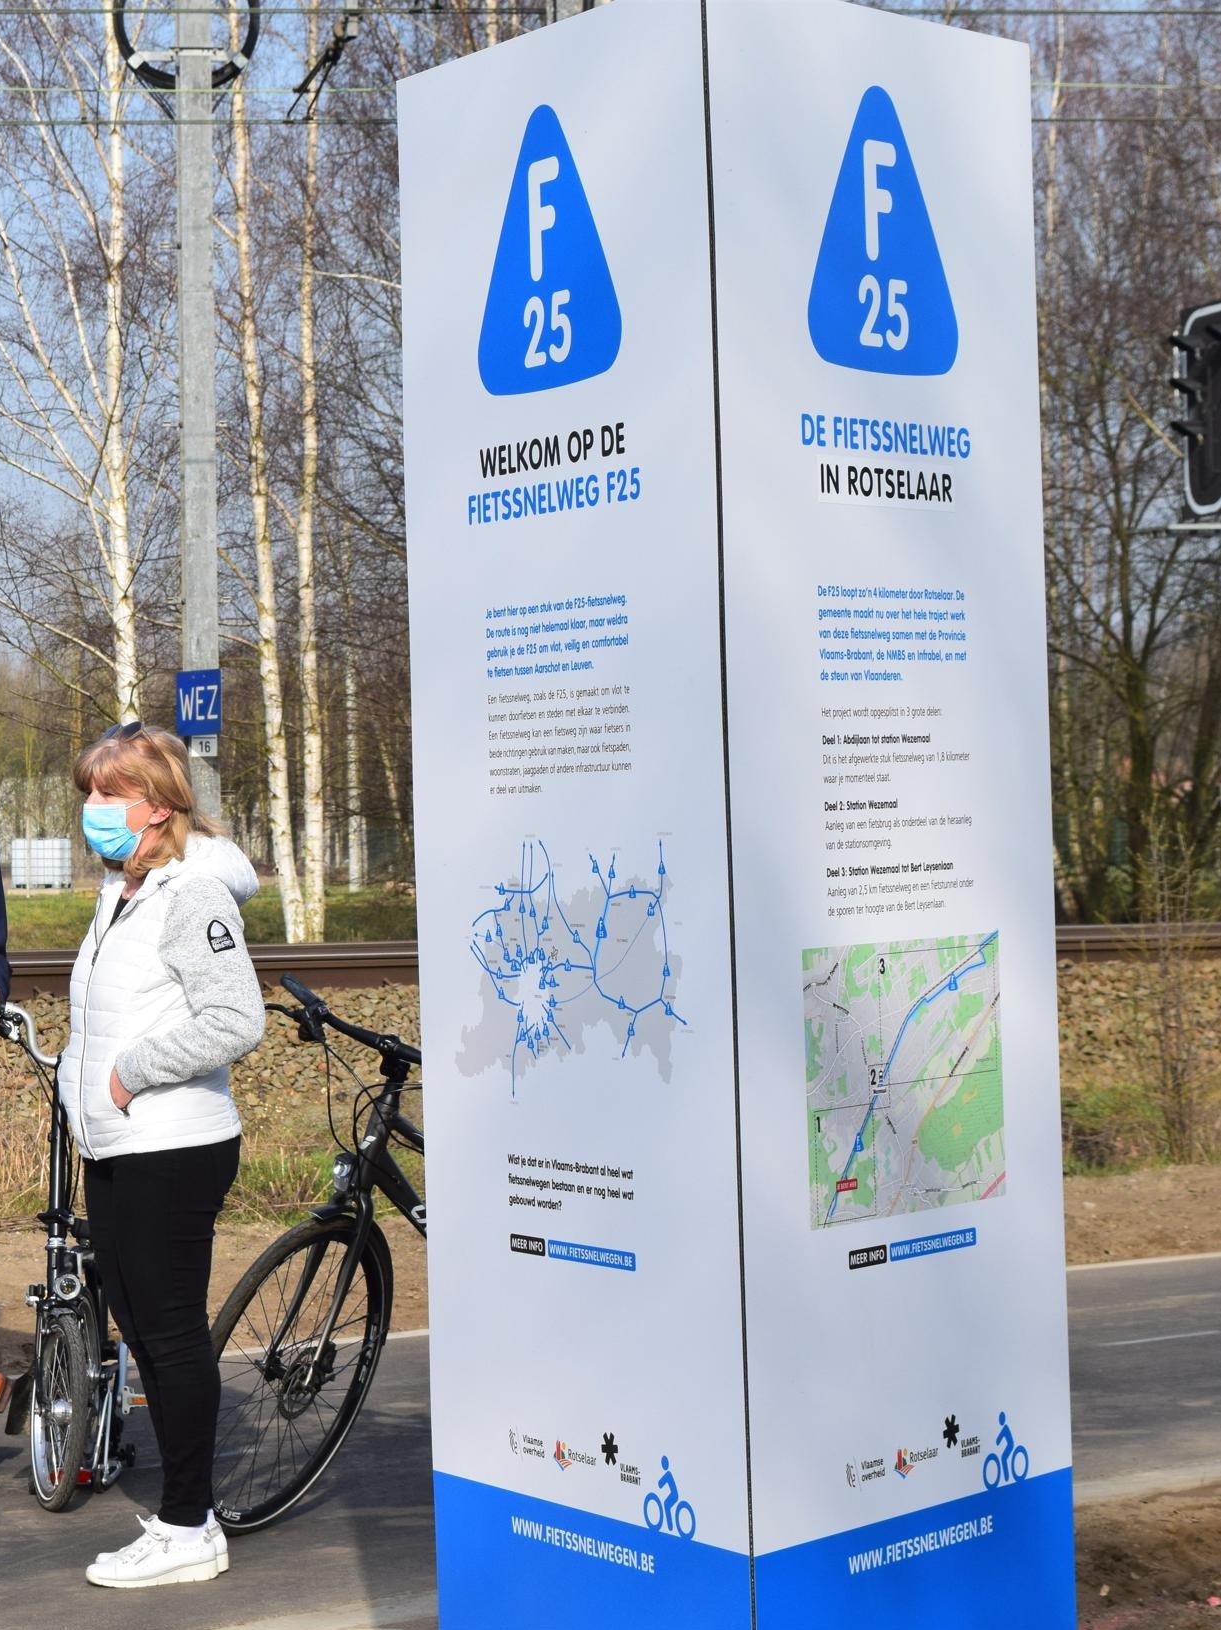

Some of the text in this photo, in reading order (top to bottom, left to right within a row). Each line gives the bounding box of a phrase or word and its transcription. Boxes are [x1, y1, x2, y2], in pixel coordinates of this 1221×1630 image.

[863, 139, 896, 261] F
[528, 156, 559, 282] F
[858, 274, 909, 351] 25
[524, 289, 572, 368] 25
[801, 414, 971, 458] DE FIETSSNELWEG
[480, 422, 625, 478] WELKOM OP DE
[820, 464, 952, 503] IN ROTSELAAR
[468, 467, 640, 526] FIETSSNELWEG F25
[818, 585, 827, 597] De
[828, 586, 840, 597] F25
[841, 586, 858, 600] loopt
[873, 587, 878, 598] 4
[878, 587, 908, 599] kilometer
[909, 588, 924, 600] door
[956, 590, 965, 601] De
[486, 609, 492, 619] Je
[493, 608, 506, 618] bent
[507, 606, 518, 616] hier
[519, 607, 527, 617] op
[528, 605, 539, 614] een
[540, 601, 552, 613] stuk
[553, 602, 564, 611] van
[565, 599, 573, 610] de
[818, 608, 852, 620] gemeente
[853, 608, 874, 619] maakt
[875, 610, 884, 620] nu
[886, 611, 900, 620] over
[901, 608, 912, 620] het
[928, 610, 948, 623] traject
[950, 610, 966, 621] werk
[486, 628, 495, 639] De
[495, 627, 511, 638] route
[511, 626, 517, 636] is
[517, 626, 529, 638] nog
[530, 623, 541, 634] niet
[542, 620, 570, 633] helemaal
[589, 618, 605, 628] maar
[606, 613, 628, 626] weldra
[819, 627, 966, 643] van deze fietssnelweg samen met de Provincie
[487, 646, 509, 661] gebruik
[510, 646, 516, 658] je
[517, 645, 525, 656] de
[526, 643, 537, 654] F25
[539, 644, 549, 654] om
[582, 640, 590, 650] en
[592, 634, 629, 648] comfortabel
[820, 648, 876, 661] Vlaams-Brabant,
[876, 649, 885, 660] de
[887, 650, 906, 661] NMBS
[907, 652, 916, 661] en
[945, 652, 953, 661] en
[955, 651, 967, 661] met
[487, 668, 493, 678] te
[494, 666, 514, 677] fietsen
[514, 666, 533, 676] tussen
[534, 662, 561, 674] Aarschot
[562, 663, 570, 672] en
[820, 669, 903, 681] de steun van Vlaanderen.
[180, 685, 218, 721] WEZ
[199, 741, 211, 753] 16
[822, 735, 836, 745] Deel
[872, 735, 880, 744] tot
[881, 734, 900, 744] station
[901, 733, 931, 744] Wezemaal
[824, 801, 838, 812] Deel
[846, 800, 867, 810] Station
[868, 799, 898, 810] Wezemaal
[827, 867, 840, 878] Deel
[849, 866, 869, 876] Station
[870, 864, 900, 875] Wezemaal
[901, 864, 909, 873] tot
[911, 863, 922, 872] Bert
[879, 958, 885, 974] 3
[870, 1069, 876, 1085] 2
[816, 1116, 820, 1133] 1
[508, 1154, 633, 1180] Wist je dat er in Vlaams-Brabant al heel wat
[508, 1173, 634, 1200] fietssnelwegen bestaan en er nog heel wat
[509, 1194, 562, 1211] gebouwd worden?
[511, 1237, 543, 1252] MEER INFO
[891, 1232, 973, 1257] WWW.FIETSSNELWEGEN.BE
[549, 1244, 633, 1267] WWW.FIETSSNELWEGEN.BE
[850, 1250, 885, 1266] MEER INFO
[522, 1435, 543, 1447] Vlaamse
[523, 1446, 545, 1459] overheid
[568, 1449, 596, 1466] Rotselaar
[909, 1447, 938, 1463] Rotselaar
[961, 1446, 980, 1458] BRABANT
[861, 1457, 884, 1470] Vlaamse
[620, 1473, 641, 1486] BRABANT
[861, 1468, 885, 1481] overheid
[511, 1516, 655, 1574] WWW.FIETSSNELWEGEN.BE
[849, 1515, 993, 1575] WWW.FIETSSNELWEGEN.BE
